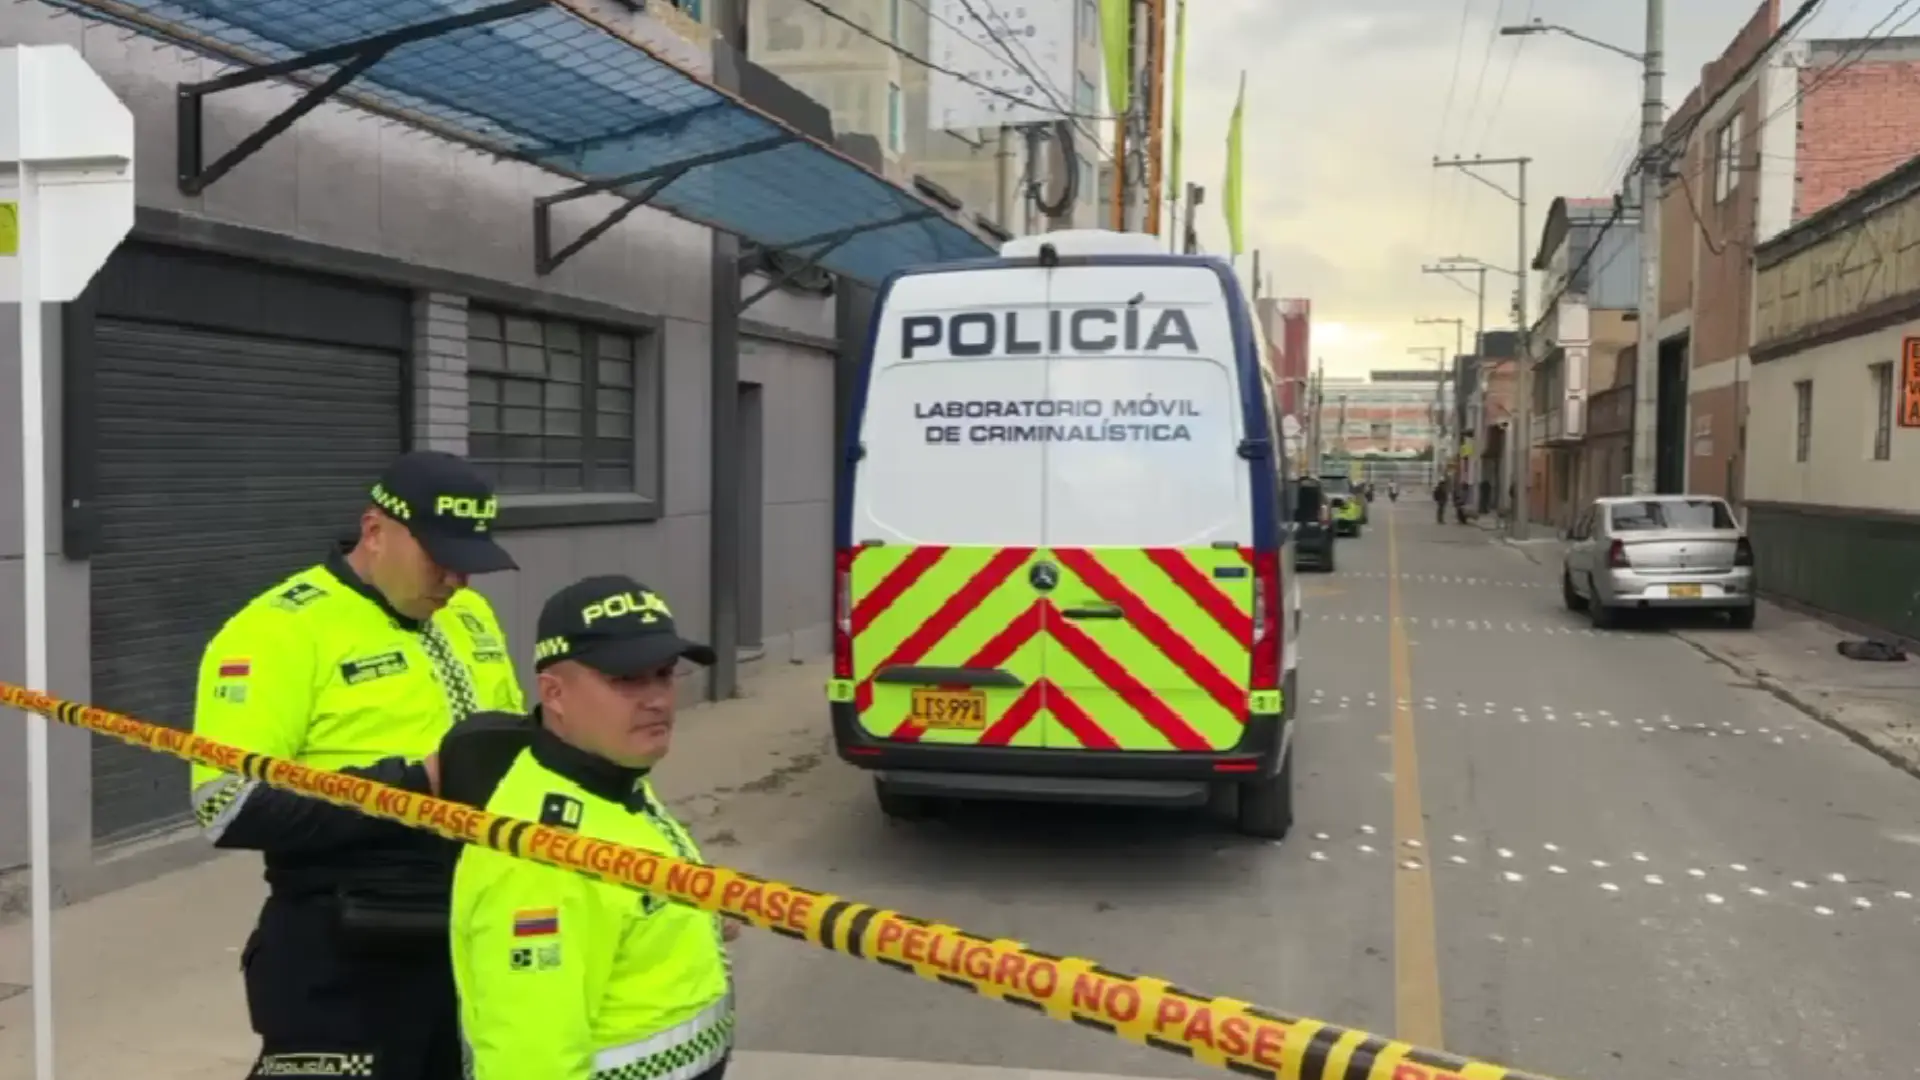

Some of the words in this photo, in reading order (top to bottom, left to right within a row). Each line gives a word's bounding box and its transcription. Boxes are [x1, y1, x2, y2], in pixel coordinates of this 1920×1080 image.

[901, 292, 1199, 359] POLICÍA
[915, 400, 1102, 419] LABORATORIO
[1112, 392, 1200, 417] MÓVIL
[925, 426, 961, 443] DE
[968, 419, 1192, 443] CRIMINALÍSTICA
[191, 736, 244, 767] PASE
[272, 762, 373, 805] PELIGRO
[376, 789, 412, 817] NO
[417, 800, 485, 836] PASE
[528, 827, 660, 886] PELIGRO
[666, 863, 716, 900] NO
[722, 879, 813, 930] PASE
[876, 918, 1059, 999] PELIGRO
[1072, 973, 1142, 1022] NO
[1153, 996, 1287, 1069] PASE
